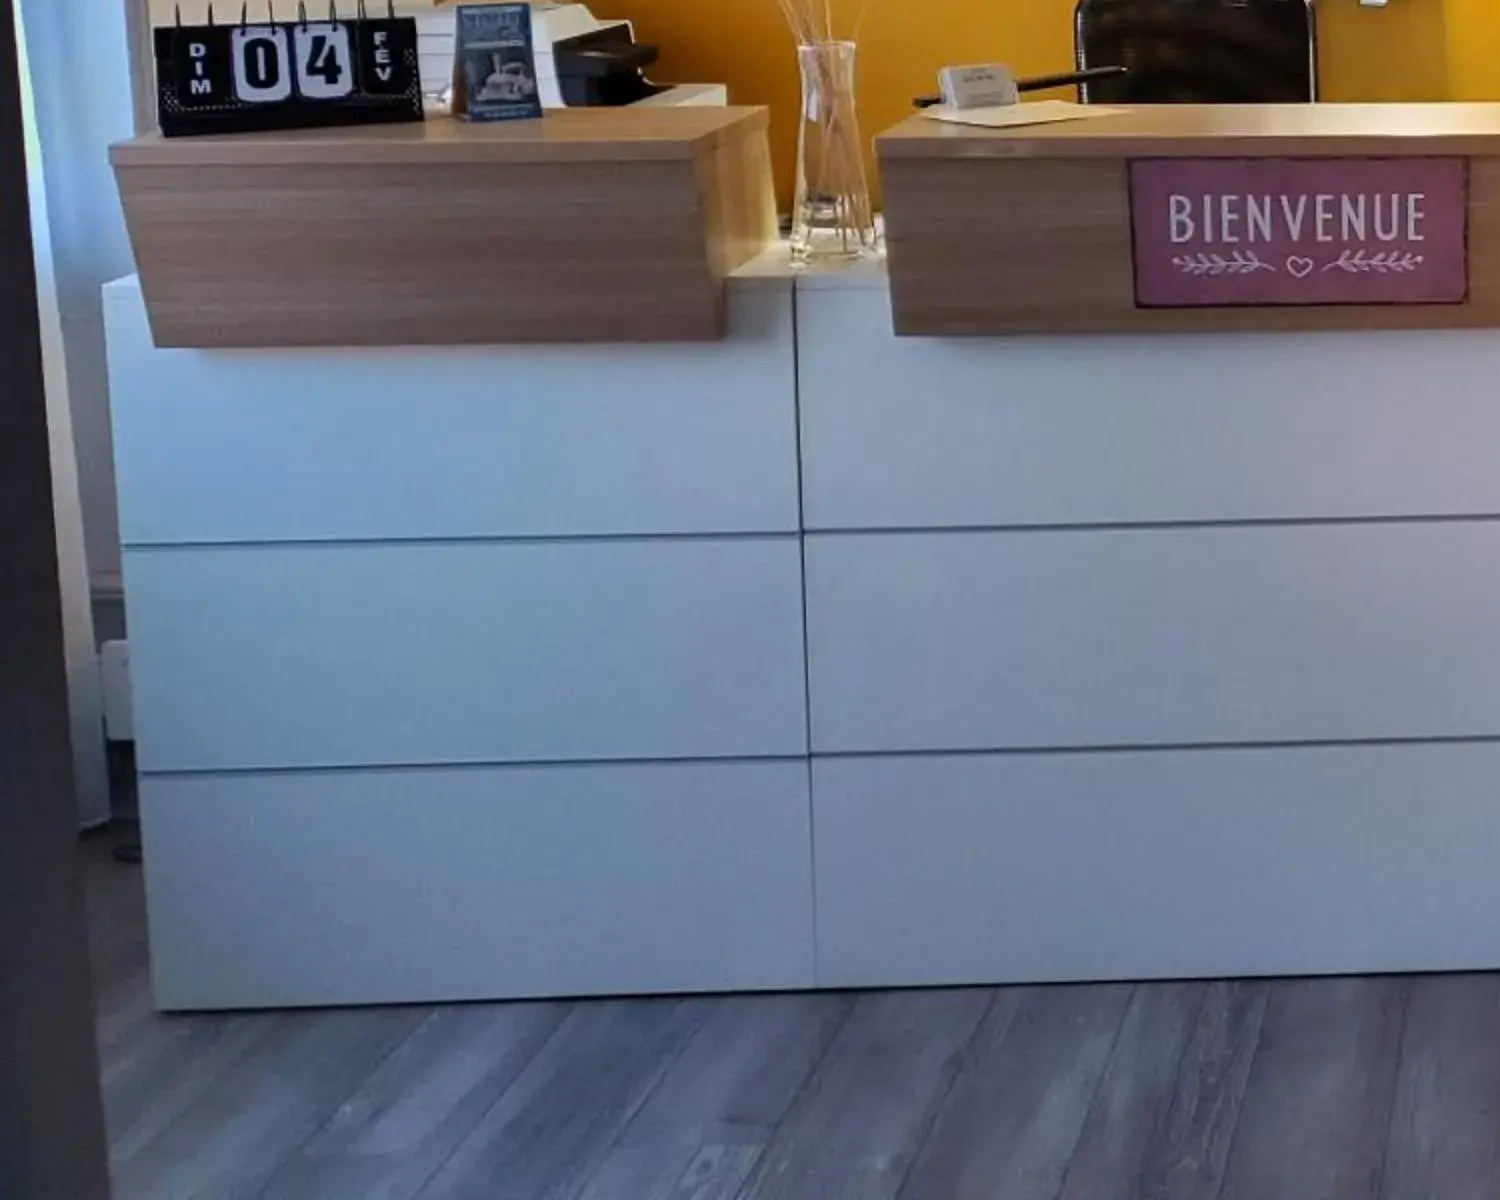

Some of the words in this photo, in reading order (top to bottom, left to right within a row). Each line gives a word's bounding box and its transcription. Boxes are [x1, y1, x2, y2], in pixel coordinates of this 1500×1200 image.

[188, 42, 213, 95] DIM
[242, 35, 343, 90] 04
[1168, 193, 1426, 243] BIENVENUE
